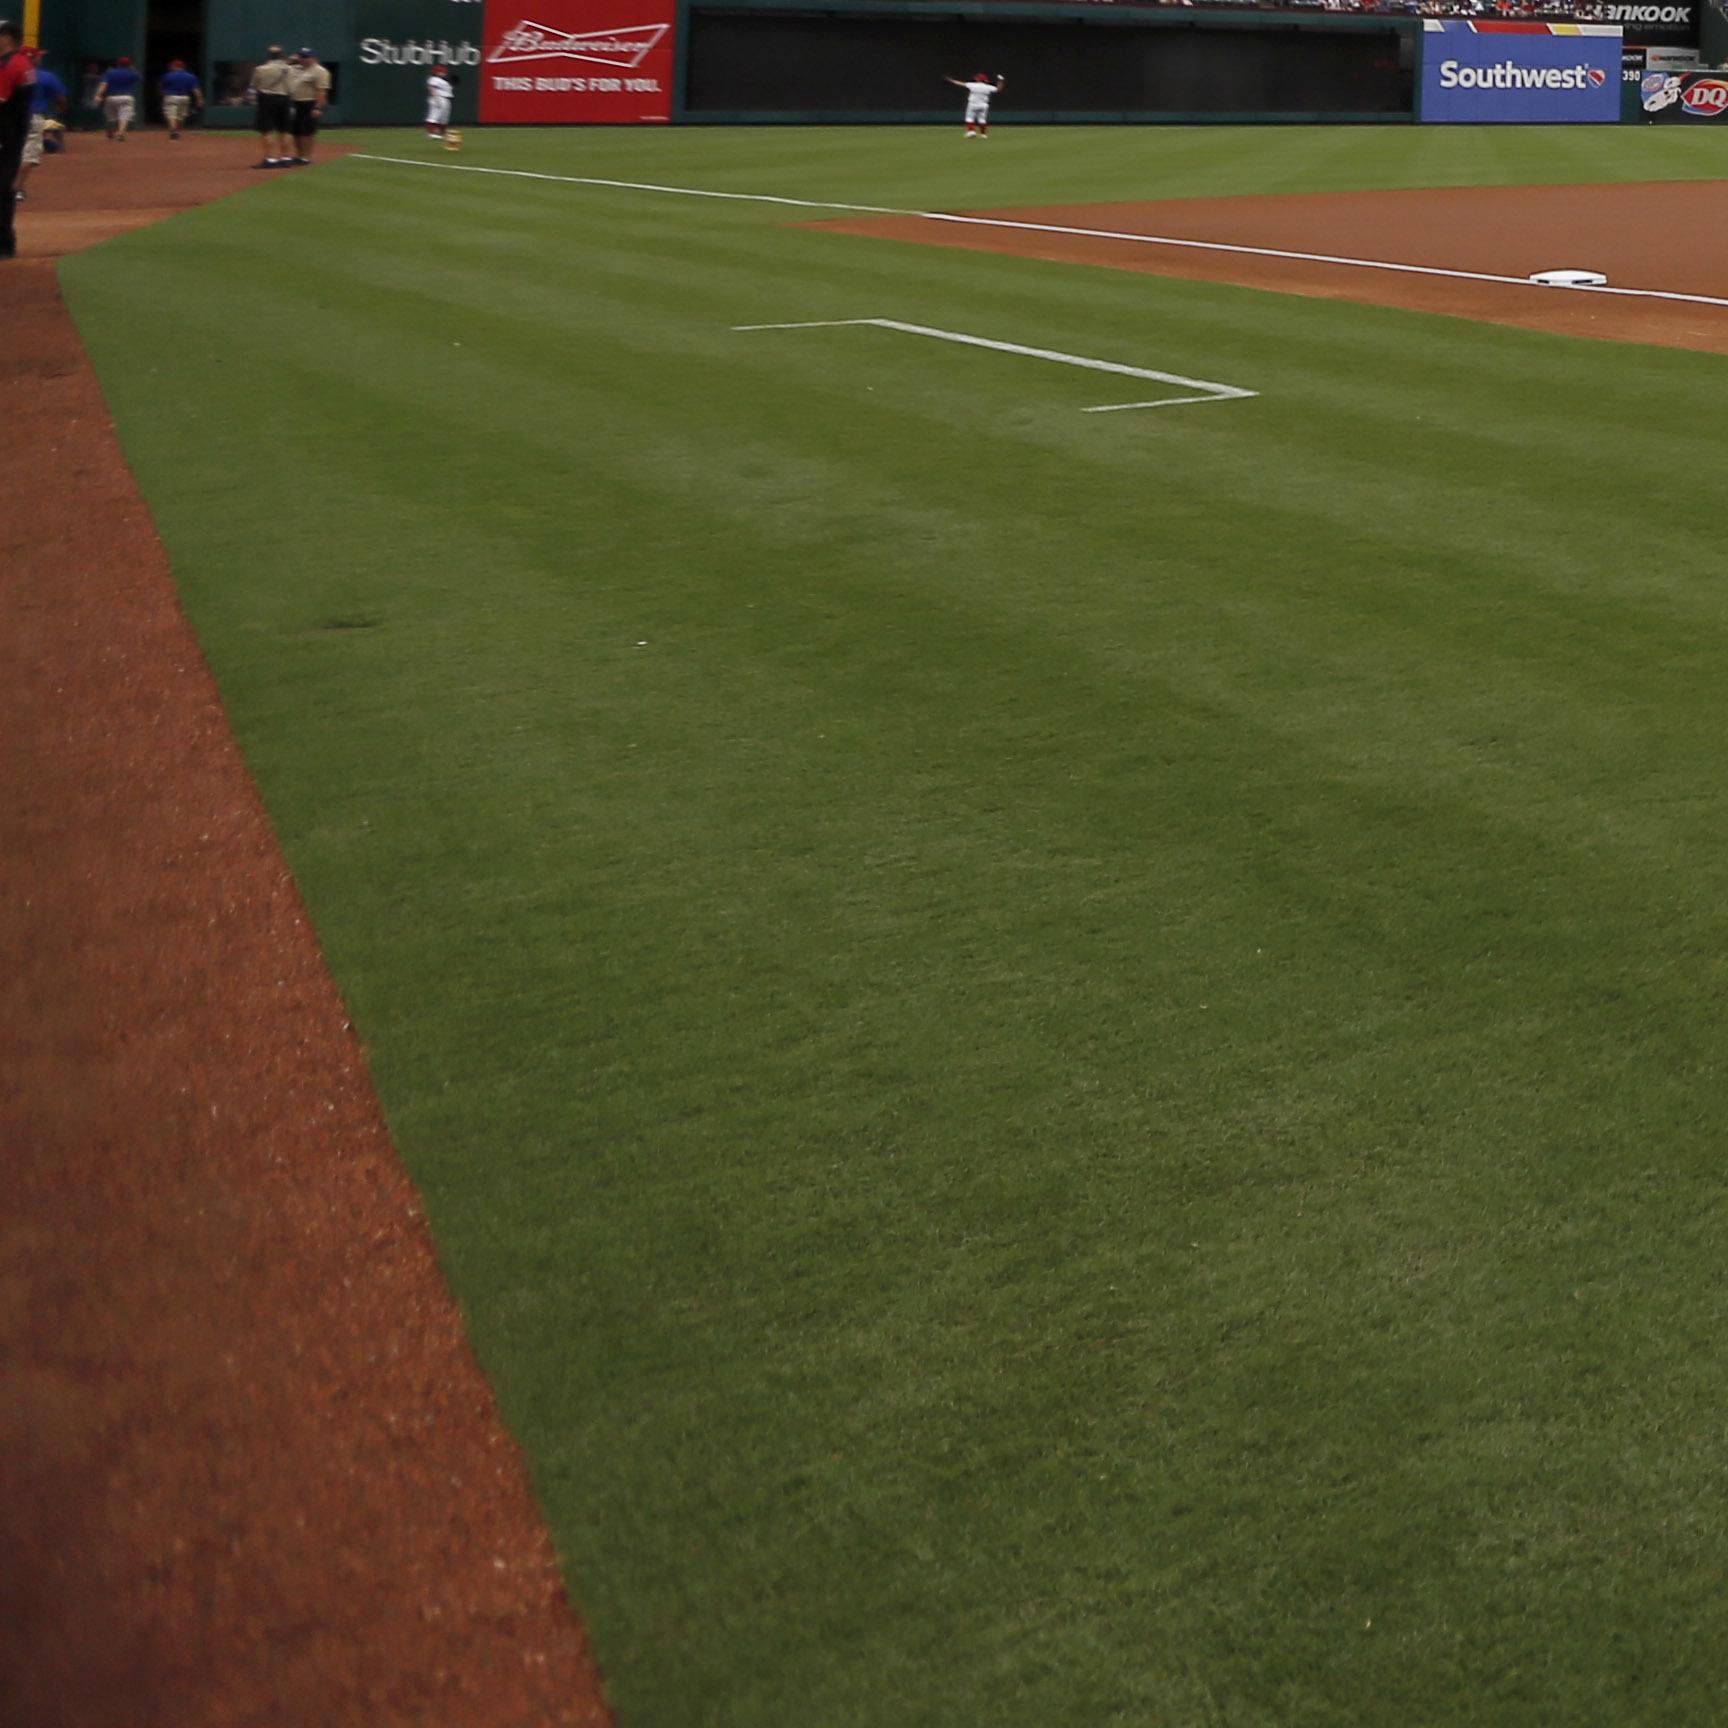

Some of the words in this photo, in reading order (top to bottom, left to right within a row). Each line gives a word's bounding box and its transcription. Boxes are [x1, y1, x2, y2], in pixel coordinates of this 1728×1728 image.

[360, 38, 482, 65] StubHub
[502, 29, 652, 53] Budweiser
[493, 76, 535, 92] THIS
[535, 76, 587, 93] BUD'S
[588, 77, 624, 93] FOR
[625, 78, 662, 93] YOU.
[1440, 60, 1587, 89] Southwest
[1622, 70, 1641, 82] 390
[1690, 87, 1727, 108] DQ
